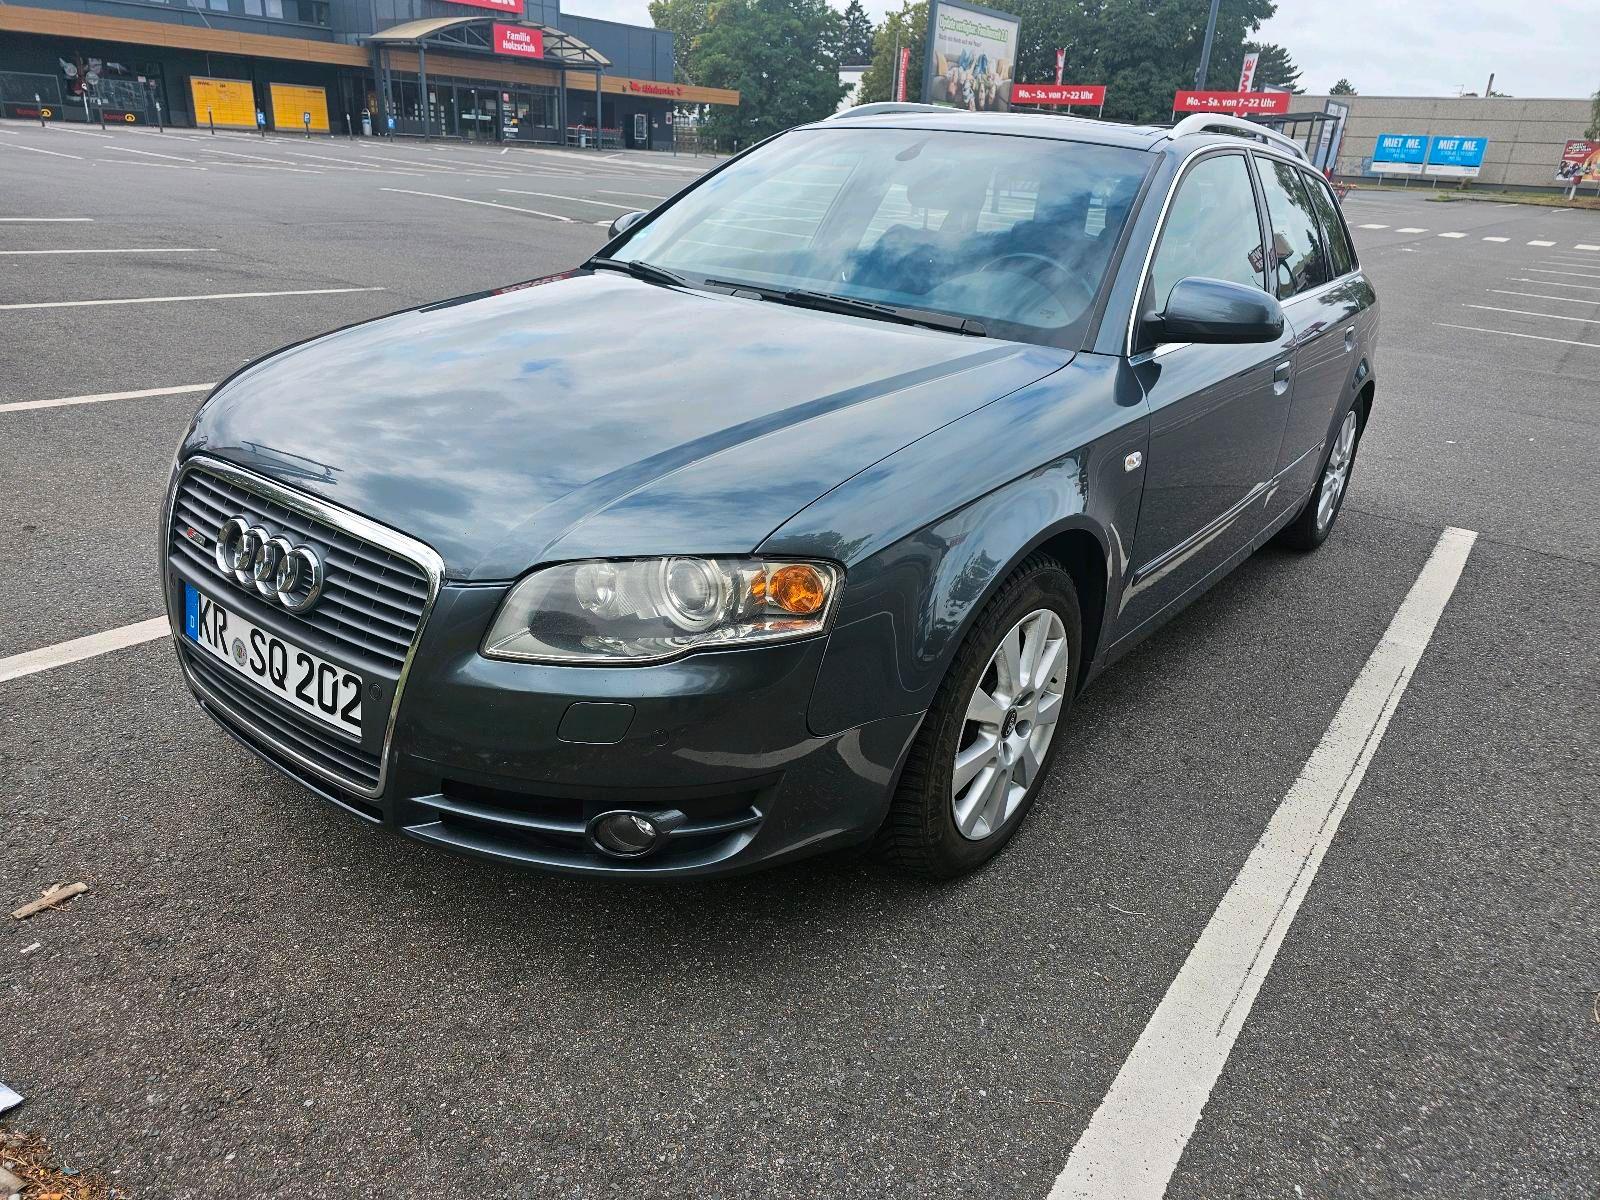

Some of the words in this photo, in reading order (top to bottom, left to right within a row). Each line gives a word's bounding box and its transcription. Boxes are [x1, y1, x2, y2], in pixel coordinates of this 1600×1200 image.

[506, 30, 531, 43] Familie
[502, 39, 536, 53] Holzschuh
[1018, 89, 1031, 98] Mo.
[1036, 90, 1047, 98] Sa.
[1081, 91, 1094, 100] Uhr
[1186, 96, 1201, 106] Mo.
[1208, 97, 1220, 107] Sa.
[1222, 99, 1237, 107] von
[1260, 98, 1276, 108] Uhr
[1383, 137, 1403, 148] MIET
[1405, 138, 1421, 149] ME.
[1438, 139, 1459, 151] MIET
[1462, 140, 1478, 151] ME.
[198, 592, 229, 656] KR
[249, 628, 289, 692] SQ
[295, 652, 362, 729] 202
